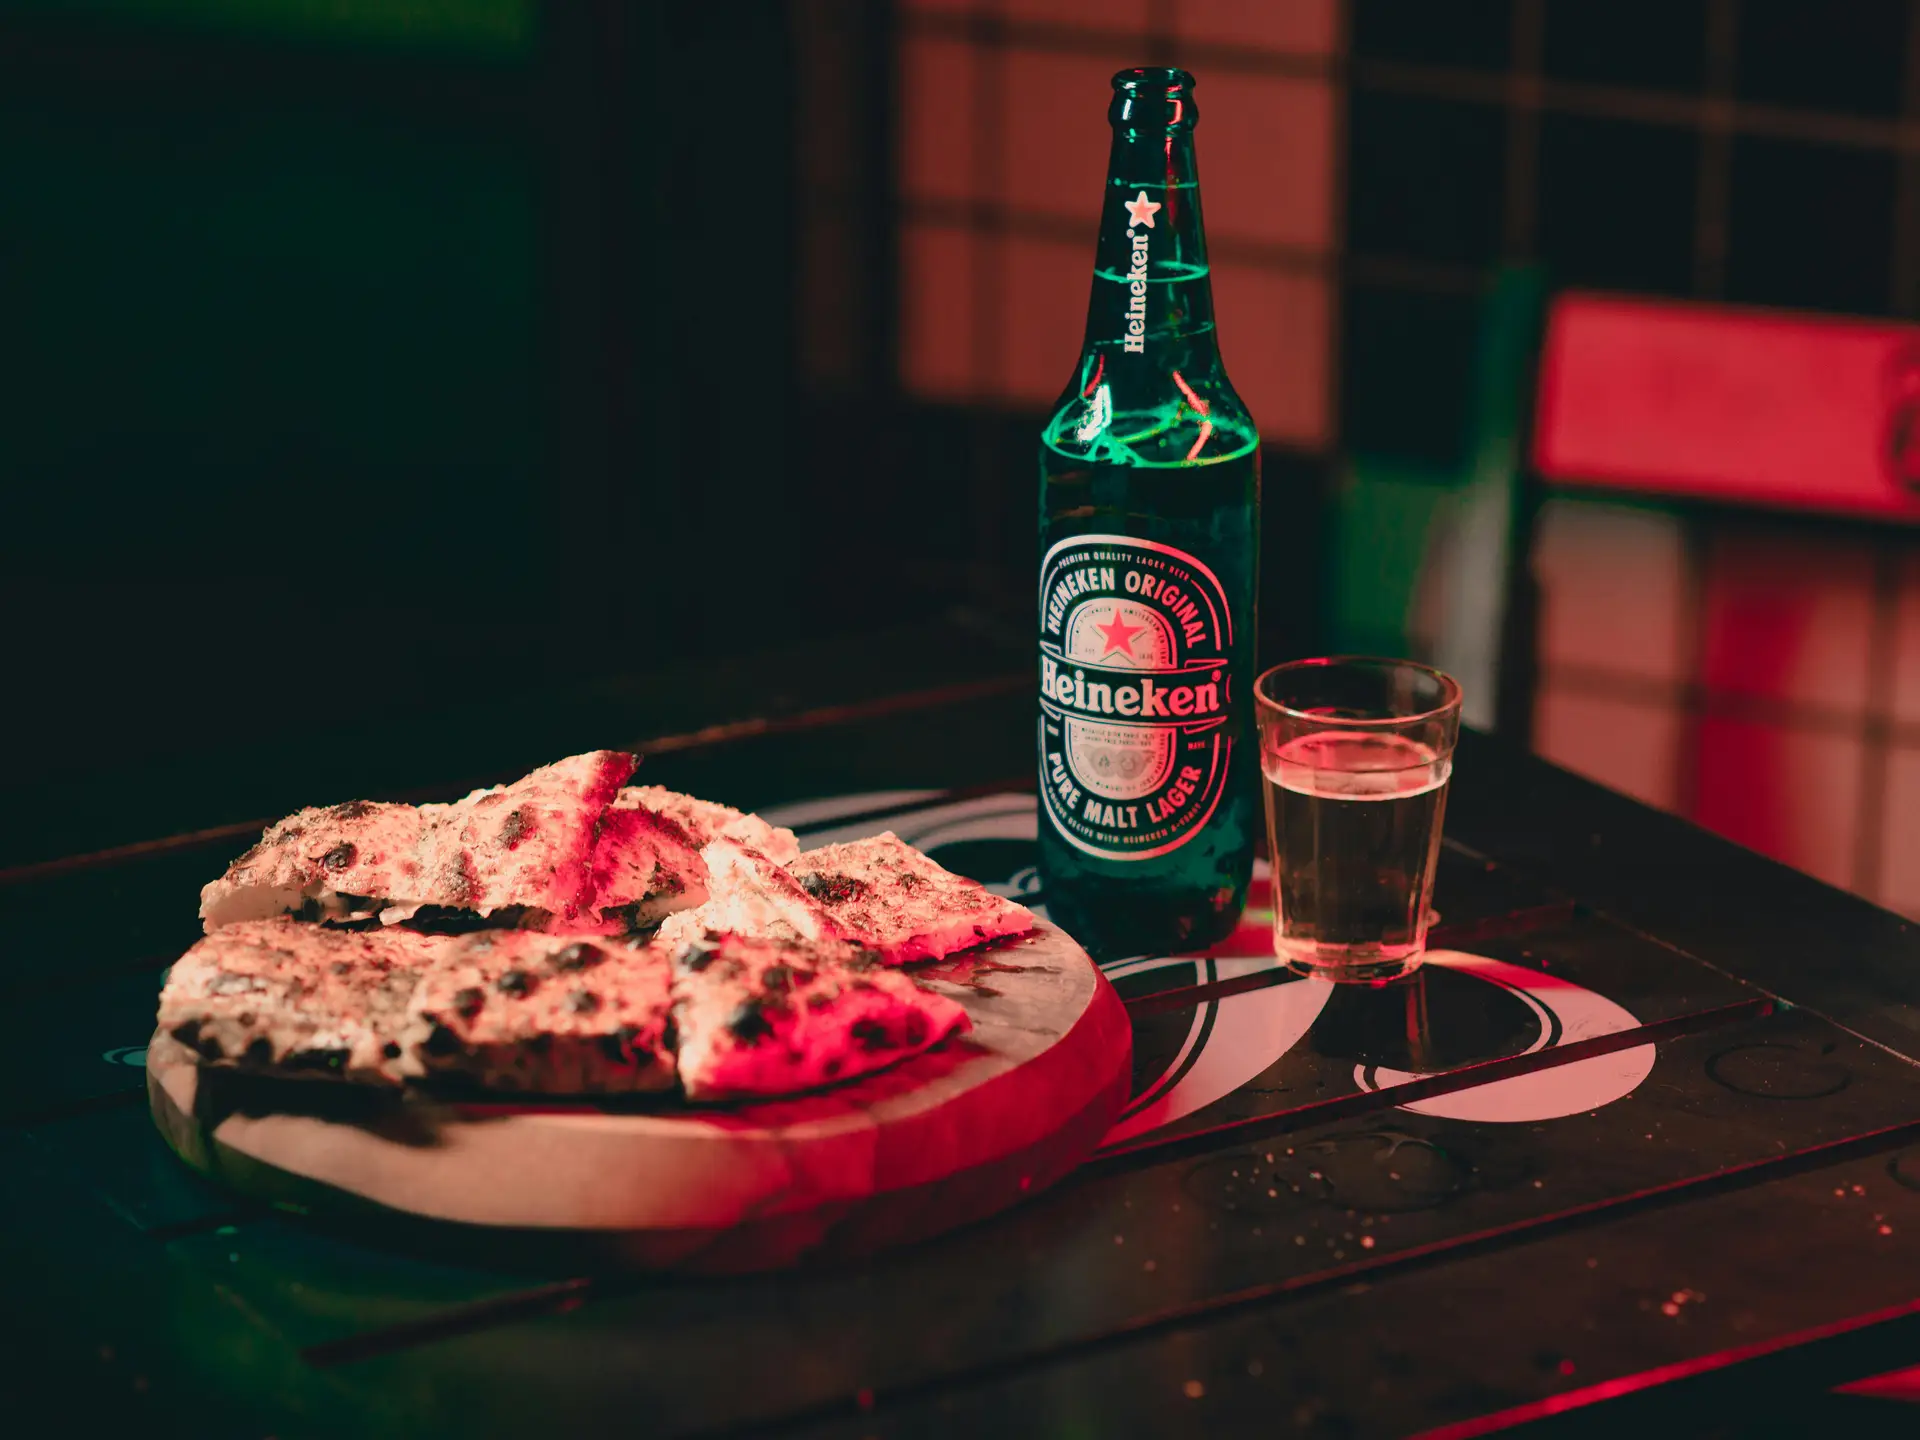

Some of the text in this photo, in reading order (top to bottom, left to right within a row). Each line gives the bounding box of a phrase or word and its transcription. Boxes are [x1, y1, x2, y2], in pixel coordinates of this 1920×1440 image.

[1124, 231, 1149, 353] Heineken
[1058, 551, 1191, 582] PREMIUM QUALITY LAGER BEER
[1047, 567, 1116, 635] HEINEKEN
[1125, 570, 1207, 649] ORIGINAL
[1041, 653, 1221, 717] Heineken
[1048, 752, 1082, 809] PURE
[1083, 799, 1138, 829] MALT
[1146, 765, 1202, 823] LAGER
[1095, 831, 1121, 844] WITH
[1122, 828, 1169, 844] HEINEKEN
